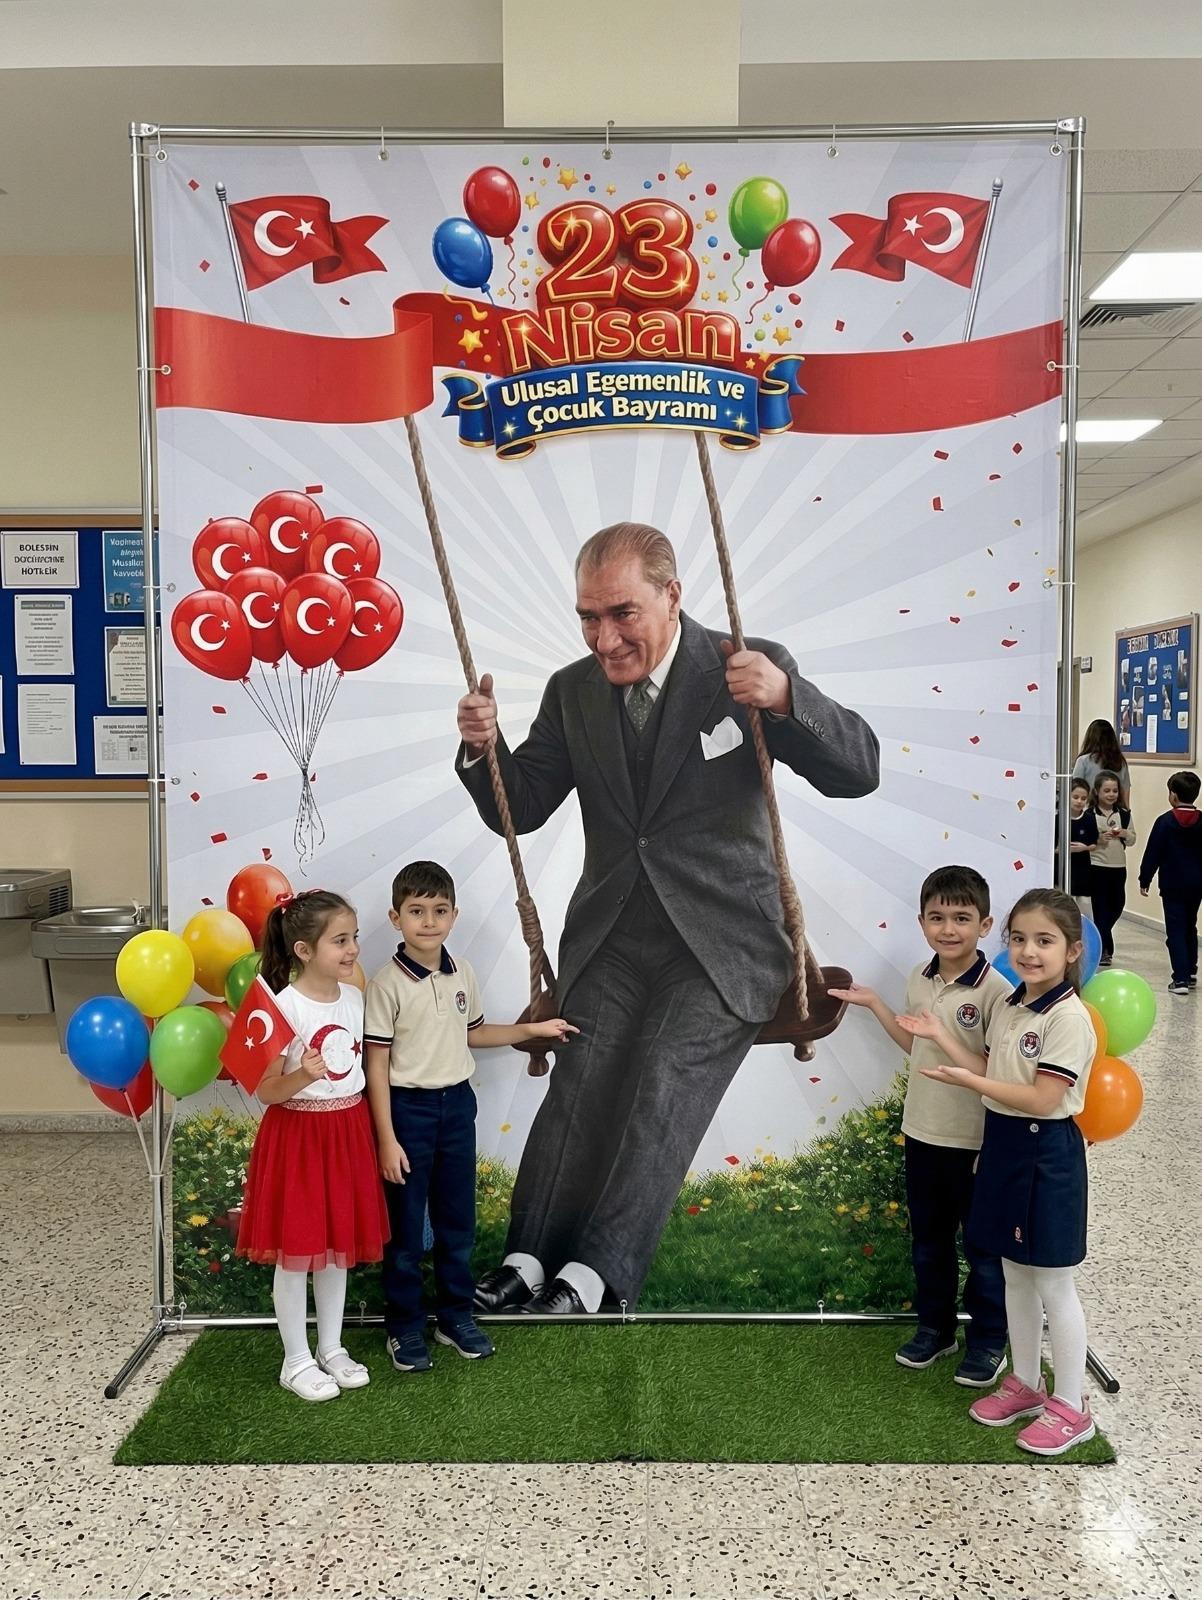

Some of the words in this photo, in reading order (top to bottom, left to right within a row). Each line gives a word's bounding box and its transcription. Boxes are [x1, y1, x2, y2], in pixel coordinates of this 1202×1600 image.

[540, 199, 696, 305] 23
[501, 301, 740, 374] Nisan
[501, 371, 579, 407] Ulusal
[586, 370, 710, 396] Egemenlik
[719, 380, 746, 400] ve
[527, 397, 605, 433] Çocuk
[612, 397, 717, 424] Bayramı
